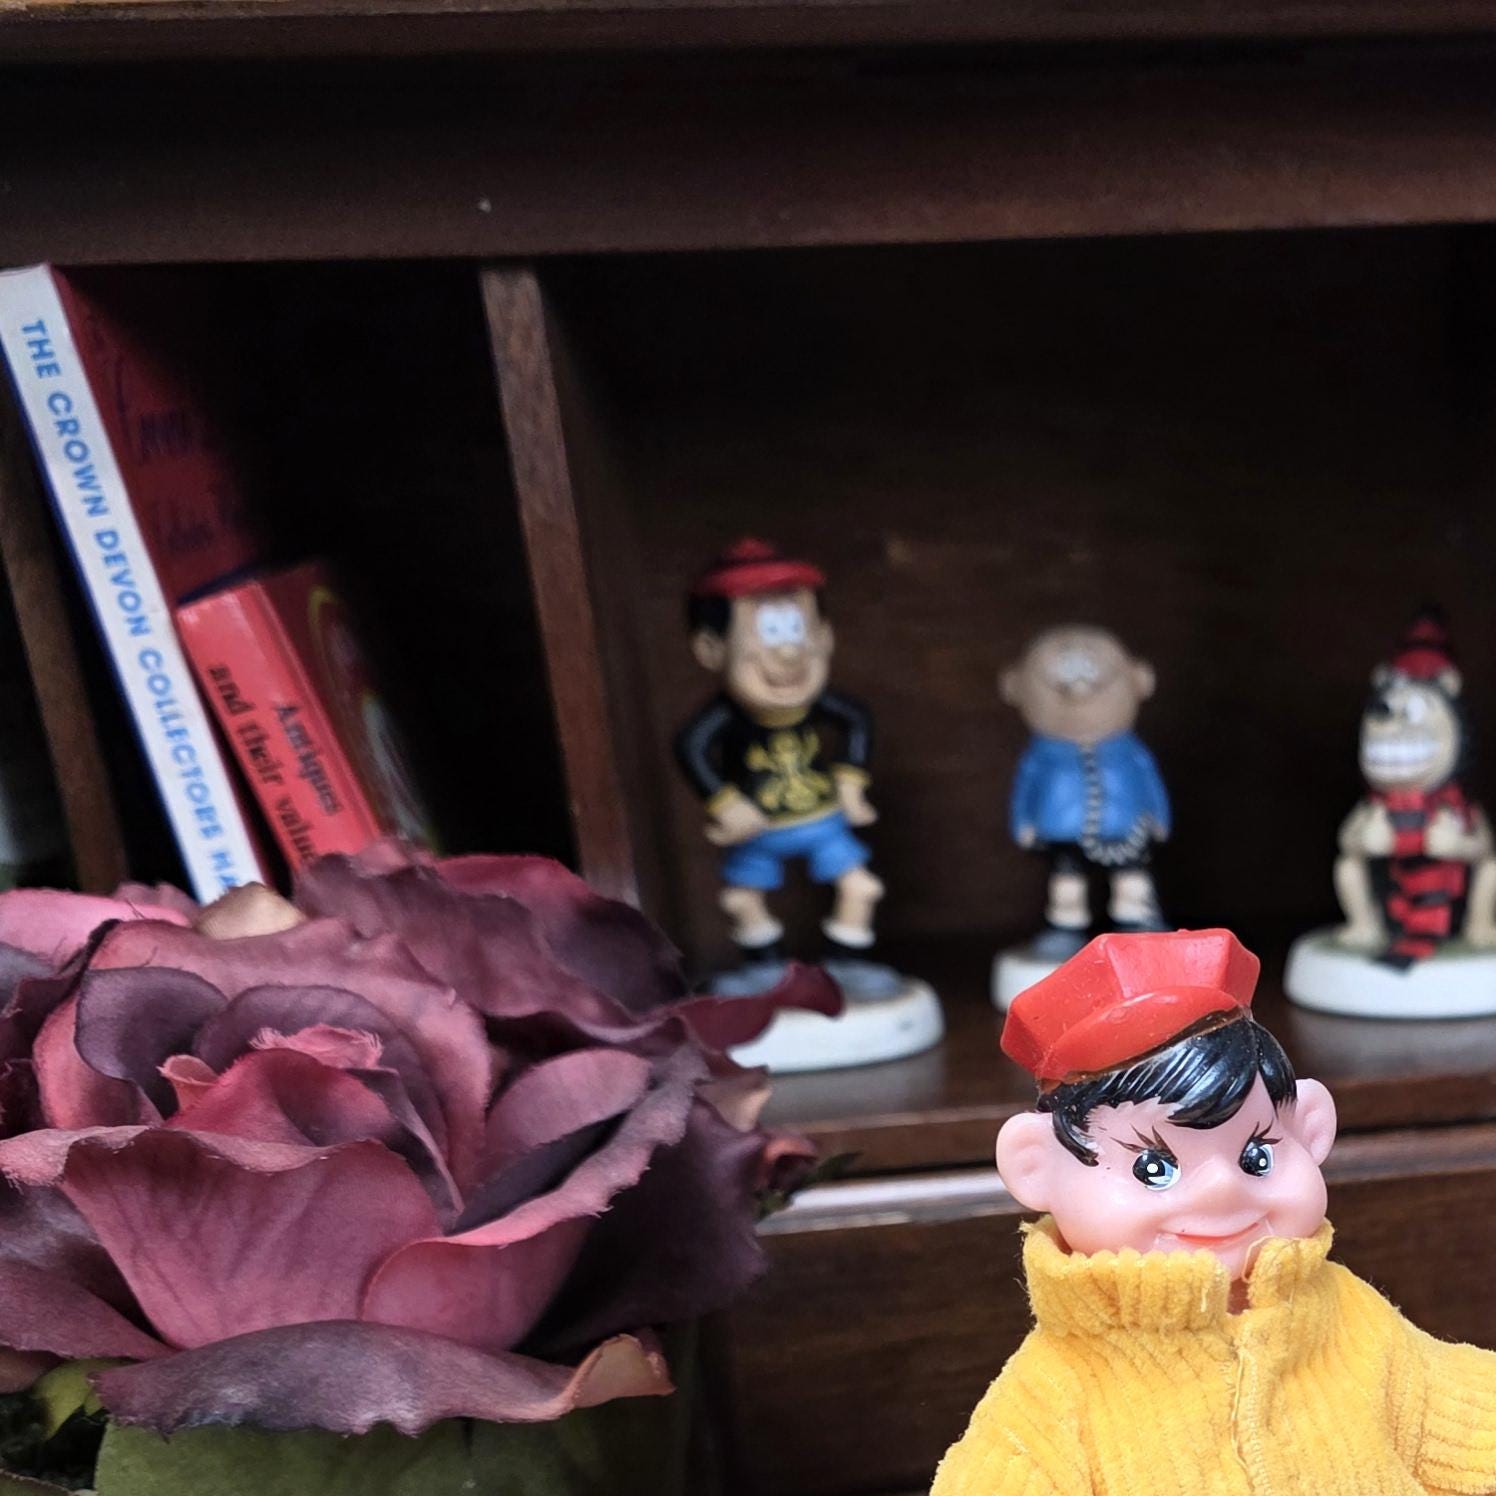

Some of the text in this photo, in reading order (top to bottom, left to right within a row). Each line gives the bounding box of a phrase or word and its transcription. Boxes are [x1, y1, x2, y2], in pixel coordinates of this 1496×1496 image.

[21, 319, 61, 379] THE
[47, 391, 109, 518] CROWN
[94, 529, 151, 638] DEVON
[208, 663, 255, 717] and
[237, 721, 284, 785] their
[275, 704, 343, 816] Antiques
